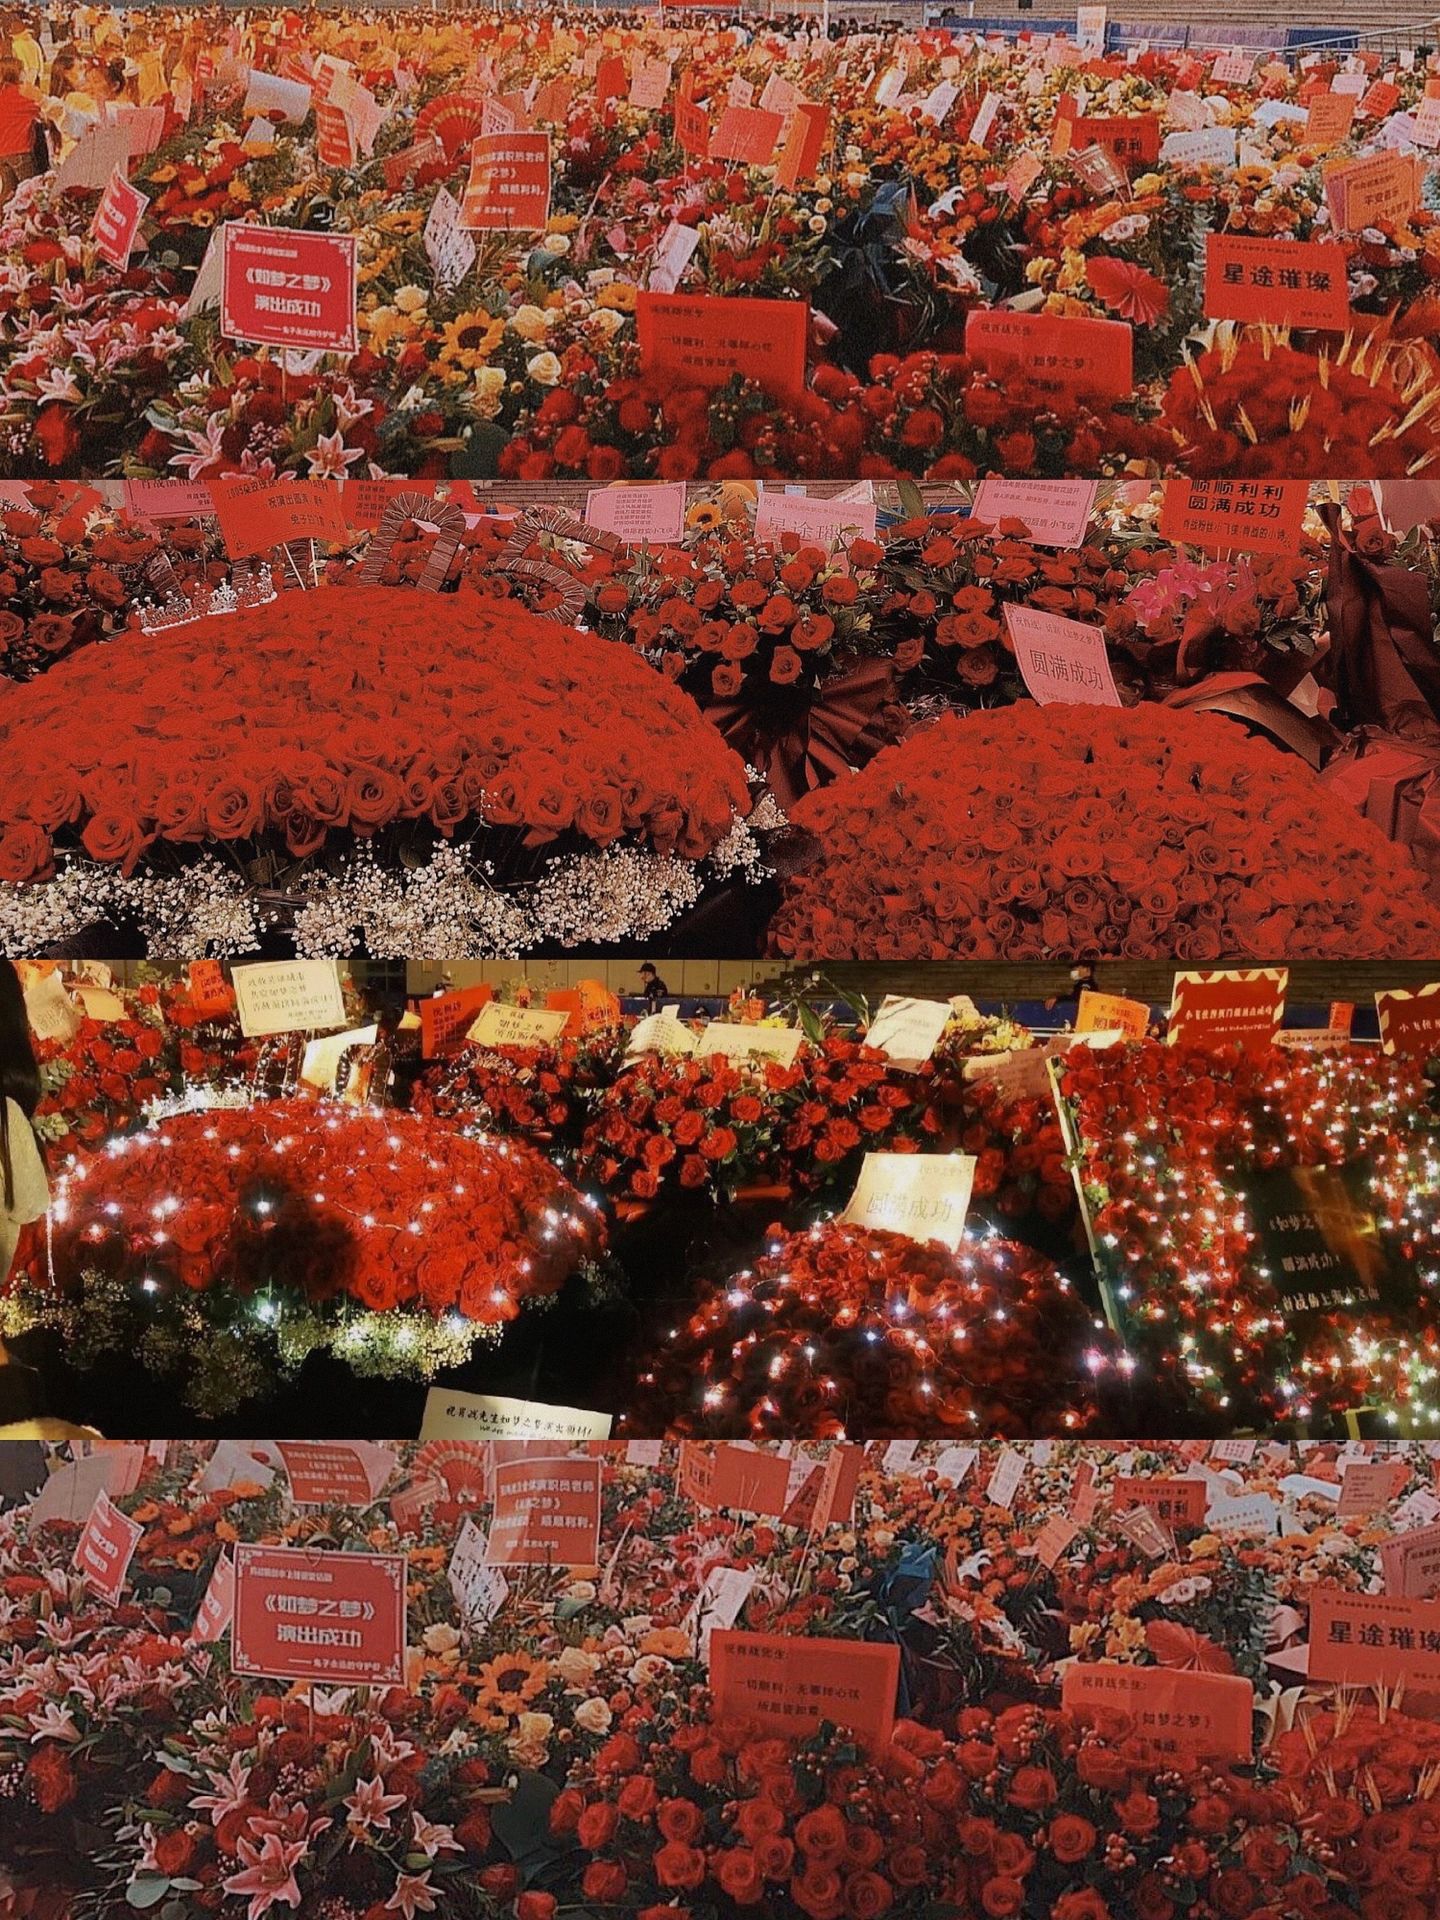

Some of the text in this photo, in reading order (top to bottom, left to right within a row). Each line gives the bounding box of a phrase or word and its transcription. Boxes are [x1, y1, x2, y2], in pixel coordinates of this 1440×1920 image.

[246, 267, 332, 293] 《如梦之梦》
[1223, 262, 1332, 292] 星途璀璨
[254, 294, 321, 318] 演出成功
[1191, 480, 1284, 501] 顺顺利利
[1188, 495, 1281, 518] 圆满成功
[767, 516, 865, 542] 星途璀
[1030, 649, 1104, 691] 圆满成功
[265, 1594, 375, 1620] 《如梦之梦》
[277, 1624, 361, 1648] 演出成功
